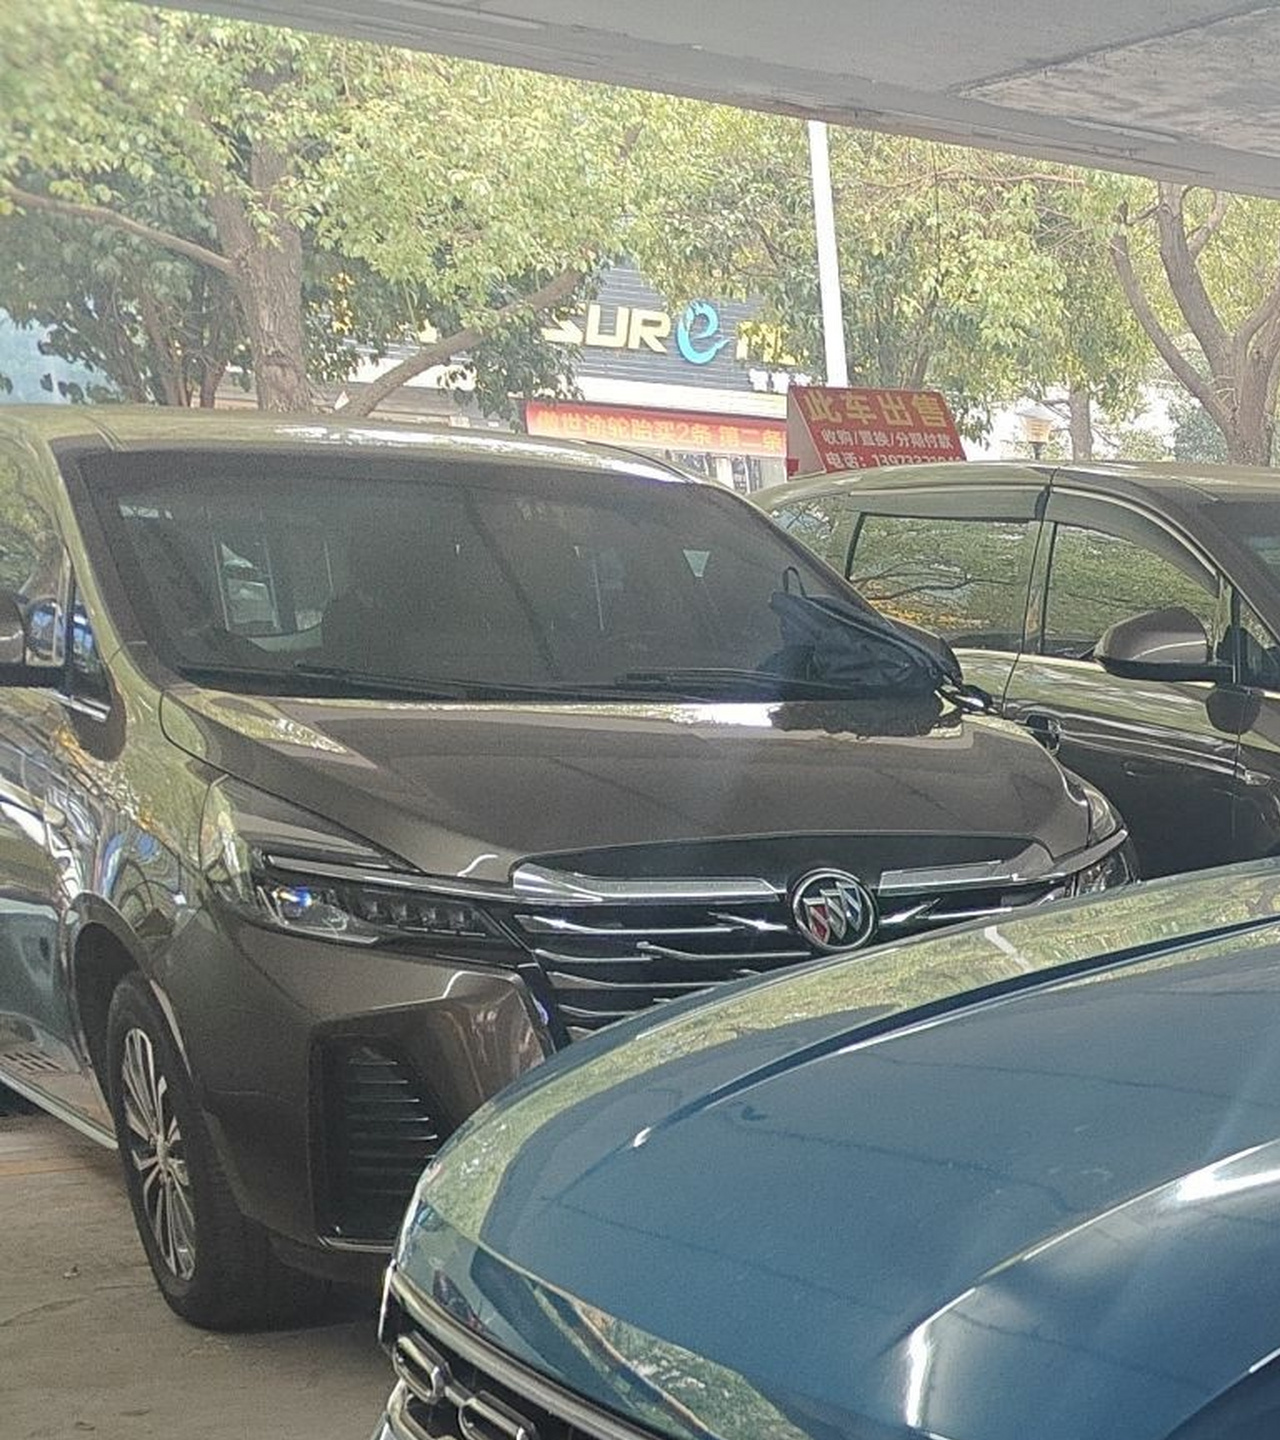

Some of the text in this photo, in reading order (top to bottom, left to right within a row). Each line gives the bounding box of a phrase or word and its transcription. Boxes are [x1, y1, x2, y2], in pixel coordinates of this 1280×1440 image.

[806, 389, 946, 427] 此车出售
[821, 429, 955, 450] 收购/置换/分期付款
